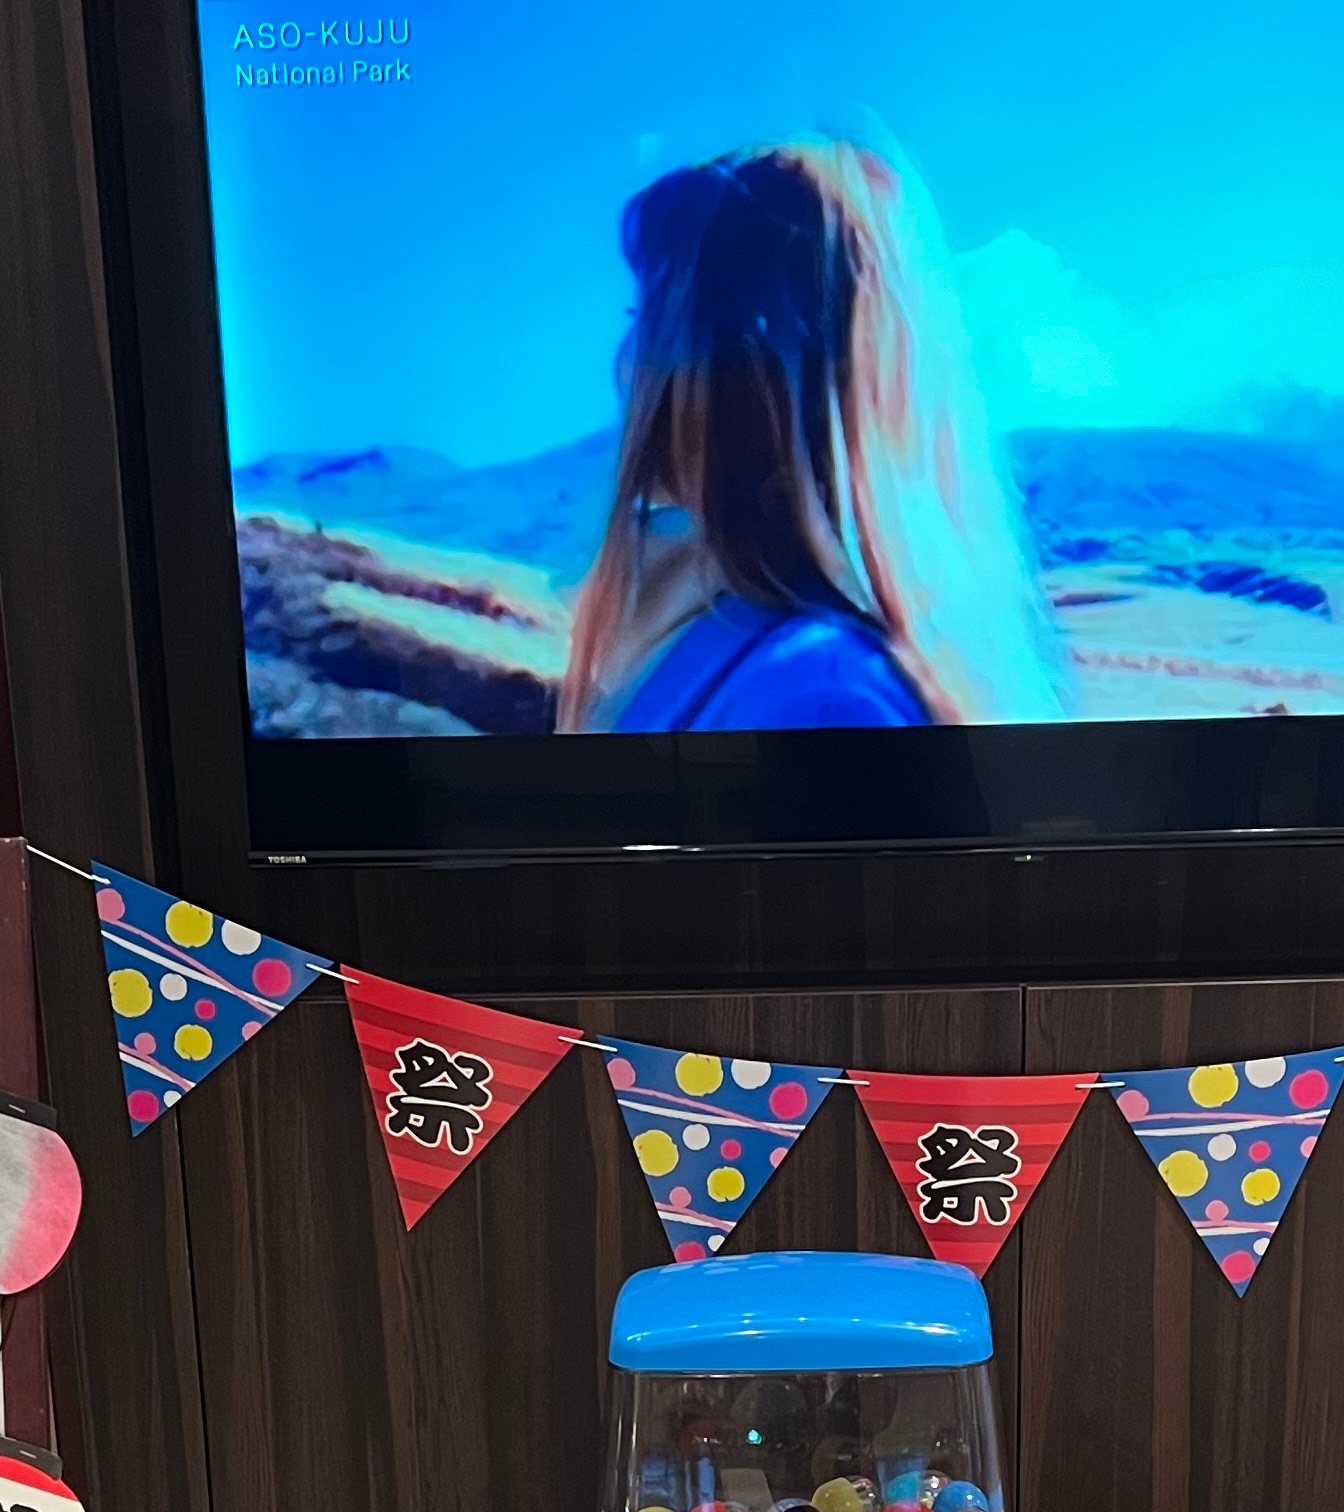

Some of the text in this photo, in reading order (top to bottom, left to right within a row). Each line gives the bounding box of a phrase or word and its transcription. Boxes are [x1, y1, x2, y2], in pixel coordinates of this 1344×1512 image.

[233, 18, 410, 50] ASO-KUJU
[236, 58, 411, 87] National Park
[267, 855, 307, 864] TOSHIBA
[385, 1037, 494, 1155] 祭
[917, 1122, 1022, 1227] 祭
